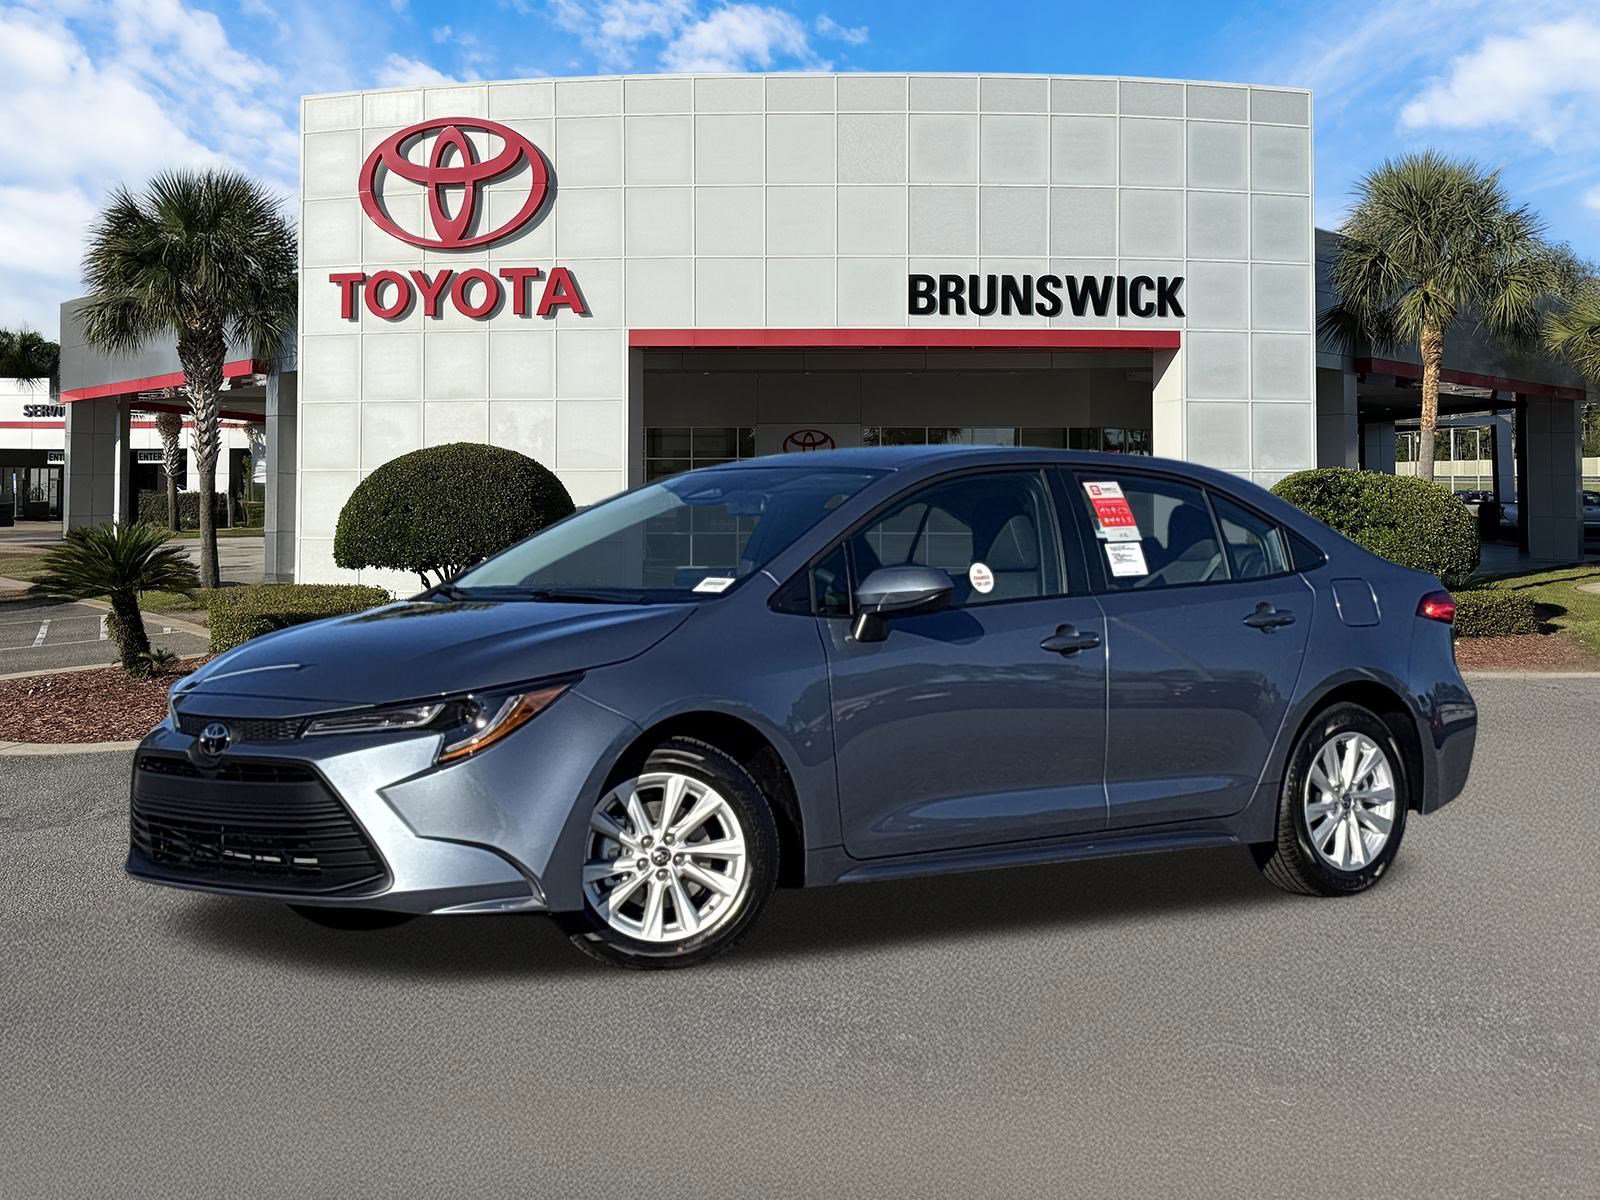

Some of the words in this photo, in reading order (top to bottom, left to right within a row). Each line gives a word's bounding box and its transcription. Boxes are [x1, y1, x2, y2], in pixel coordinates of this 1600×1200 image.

[329, 267, 586, 319] TOYOTA
[908, 274, 1185, 317] BRUNSWICK
[23, 404, 65, 417] SERVI
[48, 453, 65, 461] ENT
[139, 452, 163, 461] ENTER
